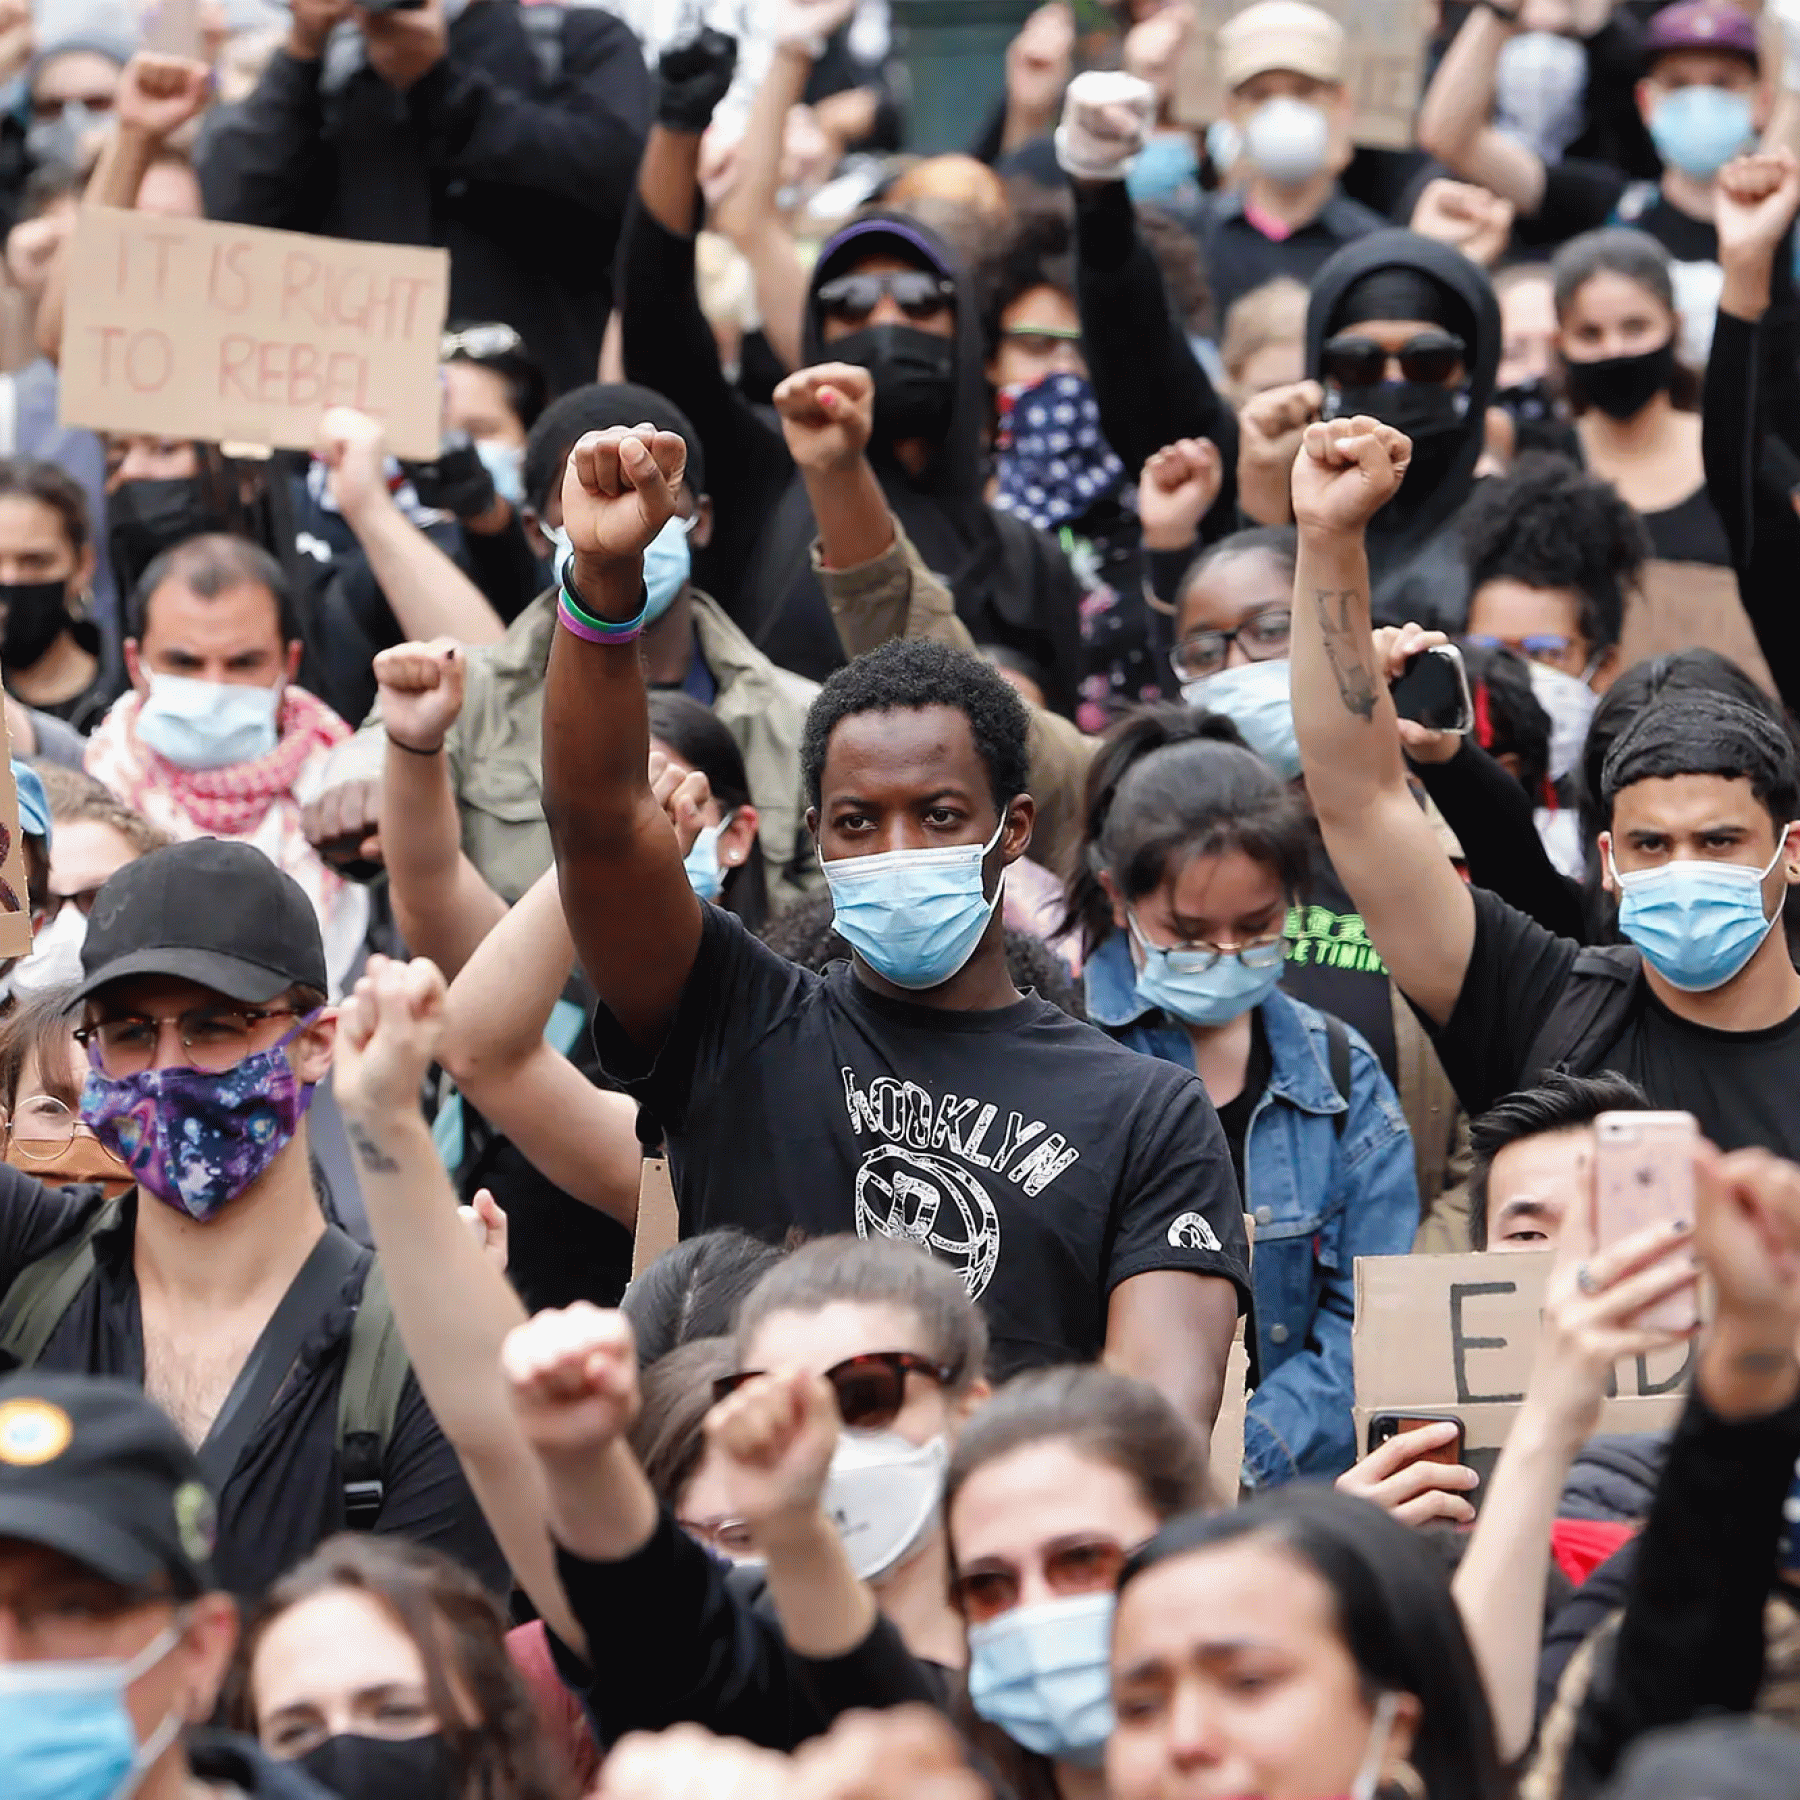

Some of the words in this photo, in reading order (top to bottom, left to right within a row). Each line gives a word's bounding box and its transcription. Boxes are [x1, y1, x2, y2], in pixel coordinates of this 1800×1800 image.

[115, 229, 187, 299] IT
[207, 240, 253, 316] IS
[281, 249, 434, 341] RIGHT
[84, 325, 174, 393] TO
[218, 332, 392, 416] REBEL
[1315, 940, 1389, 975] TIMIN
[1450, 1281, 1698, 1404] ED
